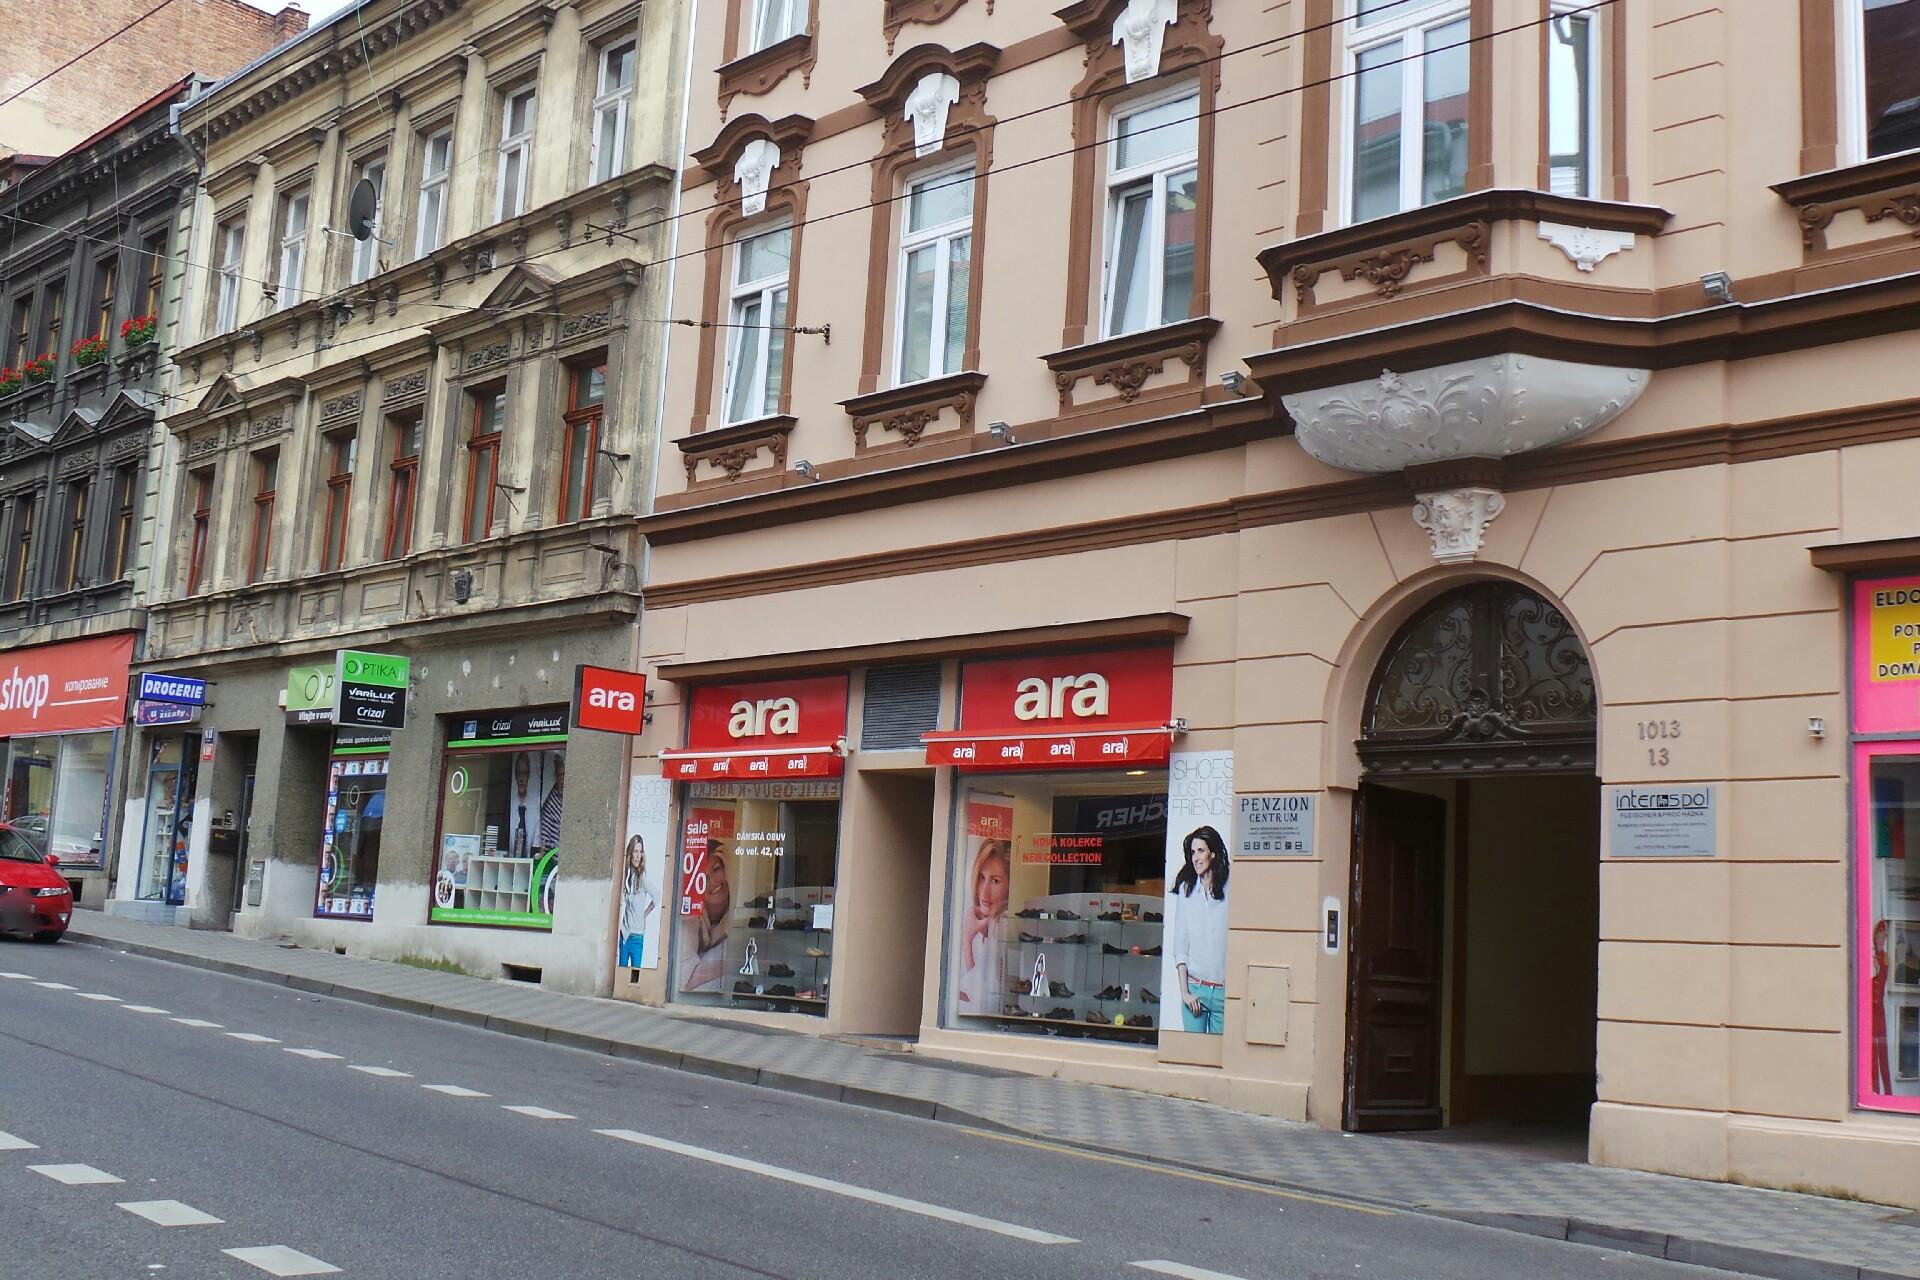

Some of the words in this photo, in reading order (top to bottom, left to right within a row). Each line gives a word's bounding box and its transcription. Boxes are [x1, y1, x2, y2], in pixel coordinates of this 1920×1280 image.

[345, 660, 397, 678] OPTIKA
[1878, 662, 1920, 677] DOM
[0, 665, 49, 719] shop
[64, 676, 109, 694] копирование
[144, 679, 204, 699] DROGERIE
[304, 674, 336, 702] OP
[589, 687, 635, 711] ara
[1013, 672, 1110, 721] ara
[356, 706, 386, 719] Crizal
[728, 696, 800, 739] ara
[491, 719, 512, 731] Crizal
[1637, 720, 1681, 740] 1013
[953, 746, 973, 759] ara
[1001, 744, 1022, 758] ara
[1050, 742, 1074, 756] ara
[1102, 740, 1124, 754] ara
[1648, 748, 1670, 766] 13
[680, 762, 695, 774] ara
[712, 760, 727, 771] ara
[750, 759, 766, 771] ara
[788, 757, 804, 770] ara
[1173, 758, 1233, 780] SHOES
[1172, 797, 1233, 816] FRIENDS
[1241, 797, 1309, 812] PENZION
[980, 815, 999, 829] ara
[1249, 812, 1298, 823] CENTRUM
[686, 819, 708, 835] sale
[766, 832, 786, 841] OBUV
[1059, 836, 1103, 848] KOLEKCE
[735, 846, 745, 856] do
[773, 846, 784, 857] 43
[1045, 851, 1102, 864] COLLECTION
[682, 851, 707, 895] %
